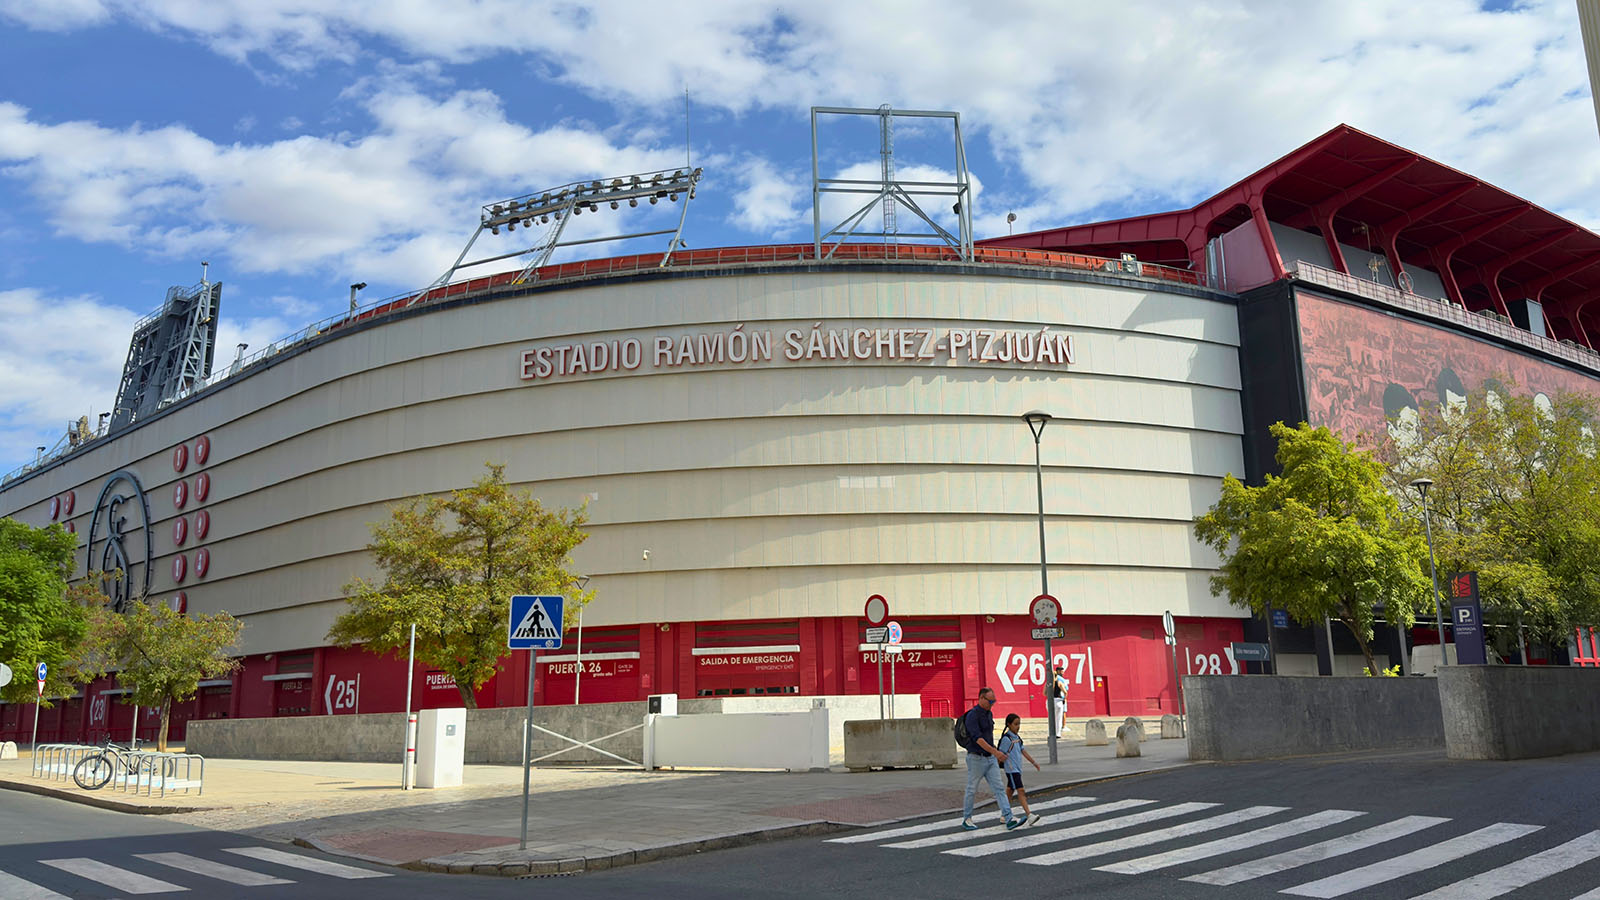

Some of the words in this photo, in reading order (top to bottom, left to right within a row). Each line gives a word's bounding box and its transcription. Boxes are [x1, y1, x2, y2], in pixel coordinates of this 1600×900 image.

[520, 337, 642, 380] ESTADIO
[654, 323, 772, 366] RAMÓN
[784, 321, 1076, 364] SÁNCHEZ-PIZJUÁN
[1458, 609, 1470, 623] P
[548, 662, 587, 675] PUERTA
[589, 661, 602, 673] 26
[701, 657, 729, 666] SALIDA
[730, 656, 741, 665] DE
[742, 654, 794, 664] EMERGENCIA
[908, 652, 922, 663] 27
[1195, 653, 1222, 675] 28
[1011, 653, 1046, 686] 26
[1053, 653, 1086, 685] 27
[335, 680, 356, 709] 25
[94, 699, 104, 721] 23
